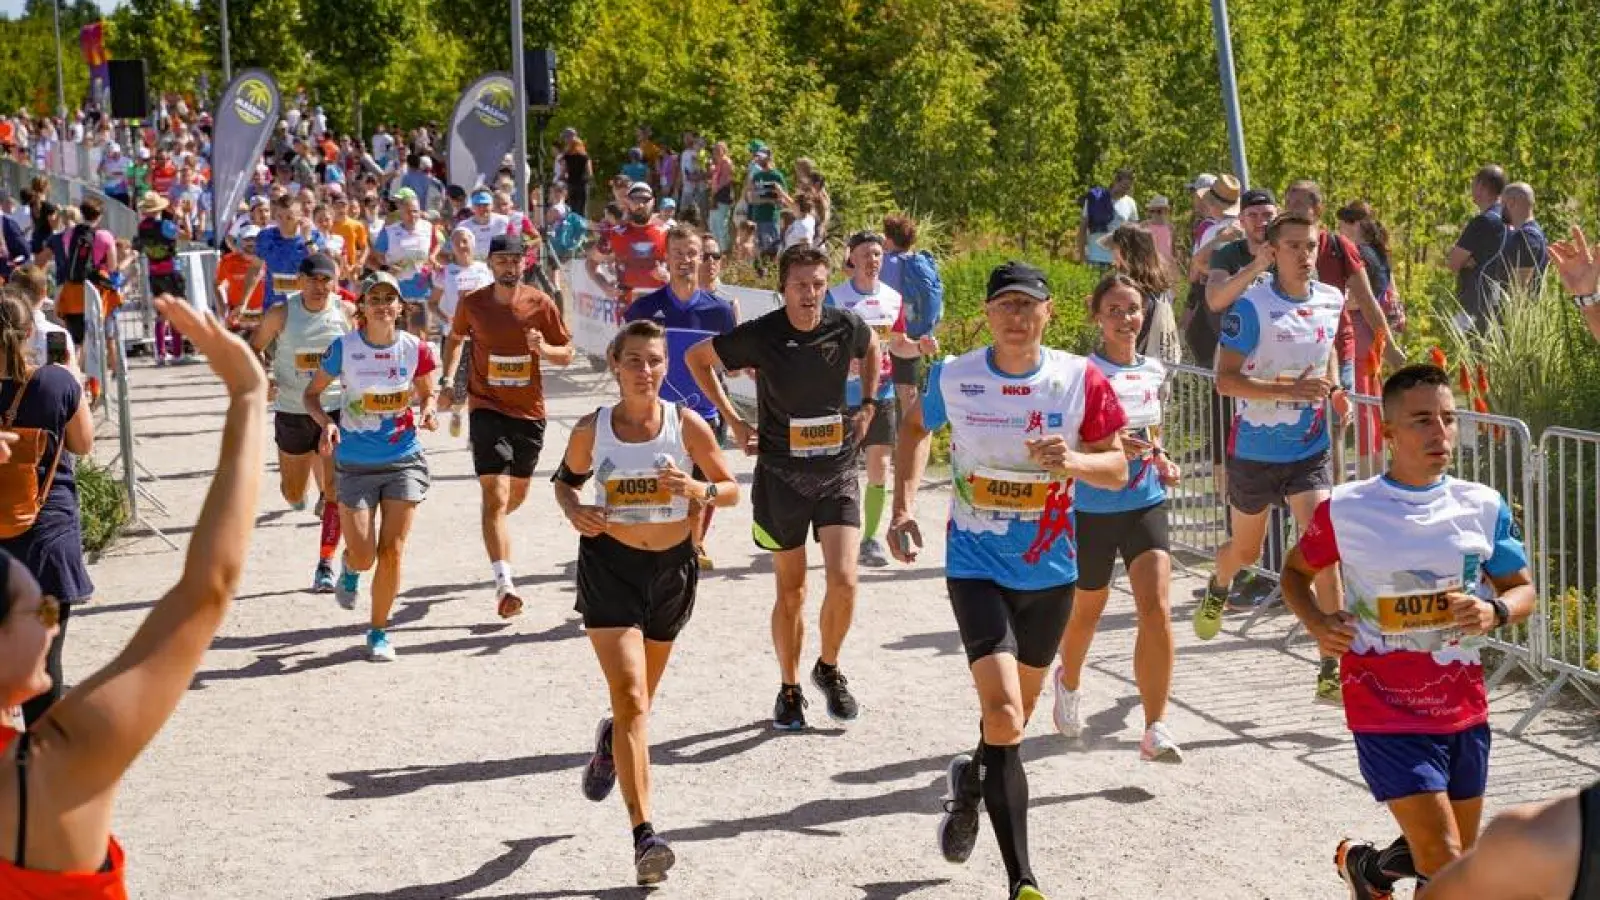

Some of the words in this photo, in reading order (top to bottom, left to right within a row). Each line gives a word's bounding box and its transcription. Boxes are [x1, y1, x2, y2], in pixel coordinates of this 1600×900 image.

[1002, 384, 1031, 395] NKD
[800, 424, 834, 439] 4089
[616, 477, 658, 495] 4093
[987, 480, 1032, 497] 4054
[1394, 591, 1449, 615] 4075
